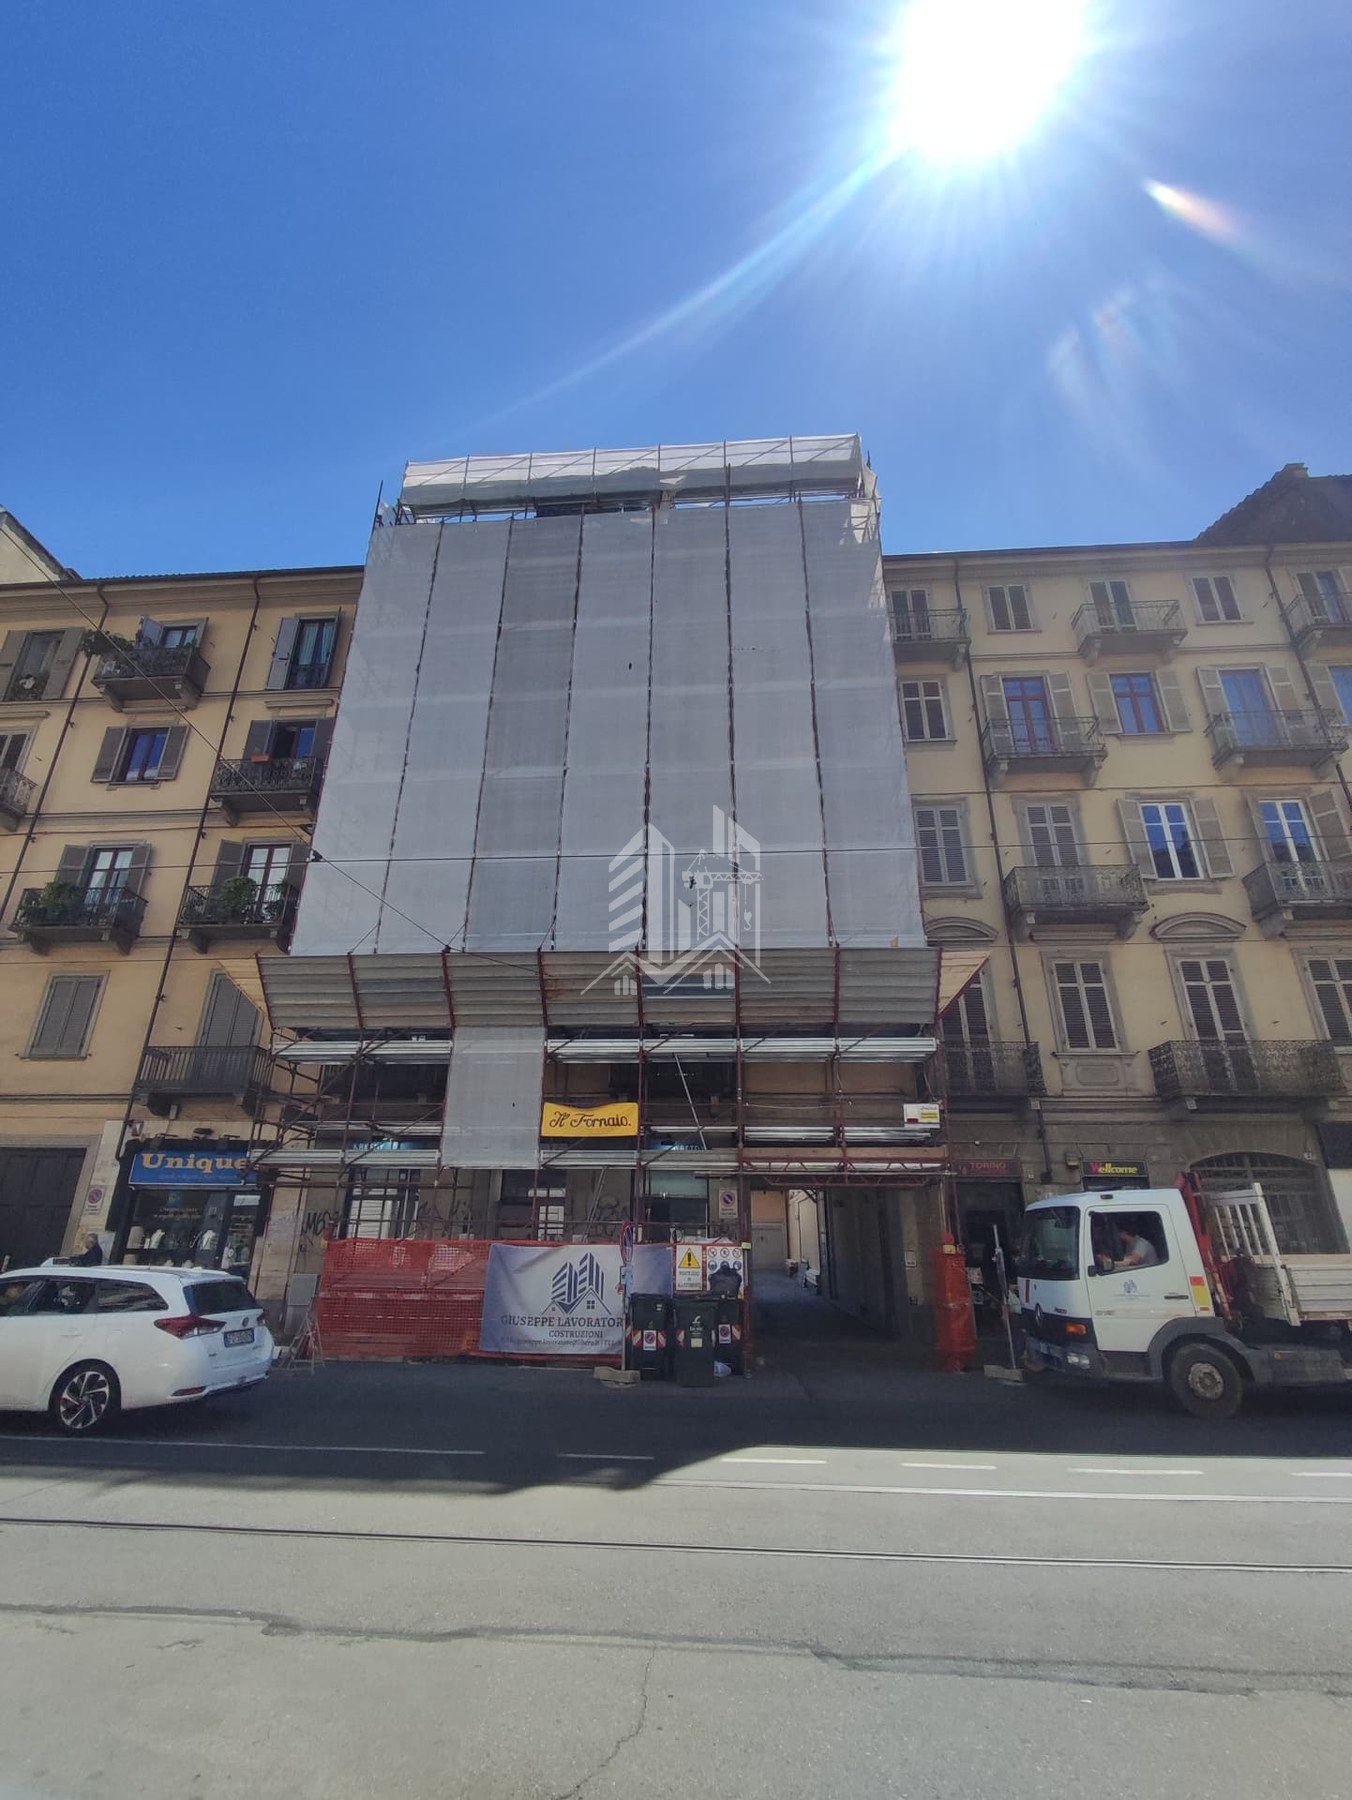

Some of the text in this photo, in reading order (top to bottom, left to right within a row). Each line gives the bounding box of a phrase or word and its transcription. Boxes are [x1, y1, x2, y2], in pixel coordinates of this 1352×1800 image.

[549, 1111, 570, 1128] Il
[141, 1153, 247, 1173] Unique
[501, 1315, 555, 1327] GIUSEPPE
[548, 1330, 604, 1339] COSTRUZIONI
